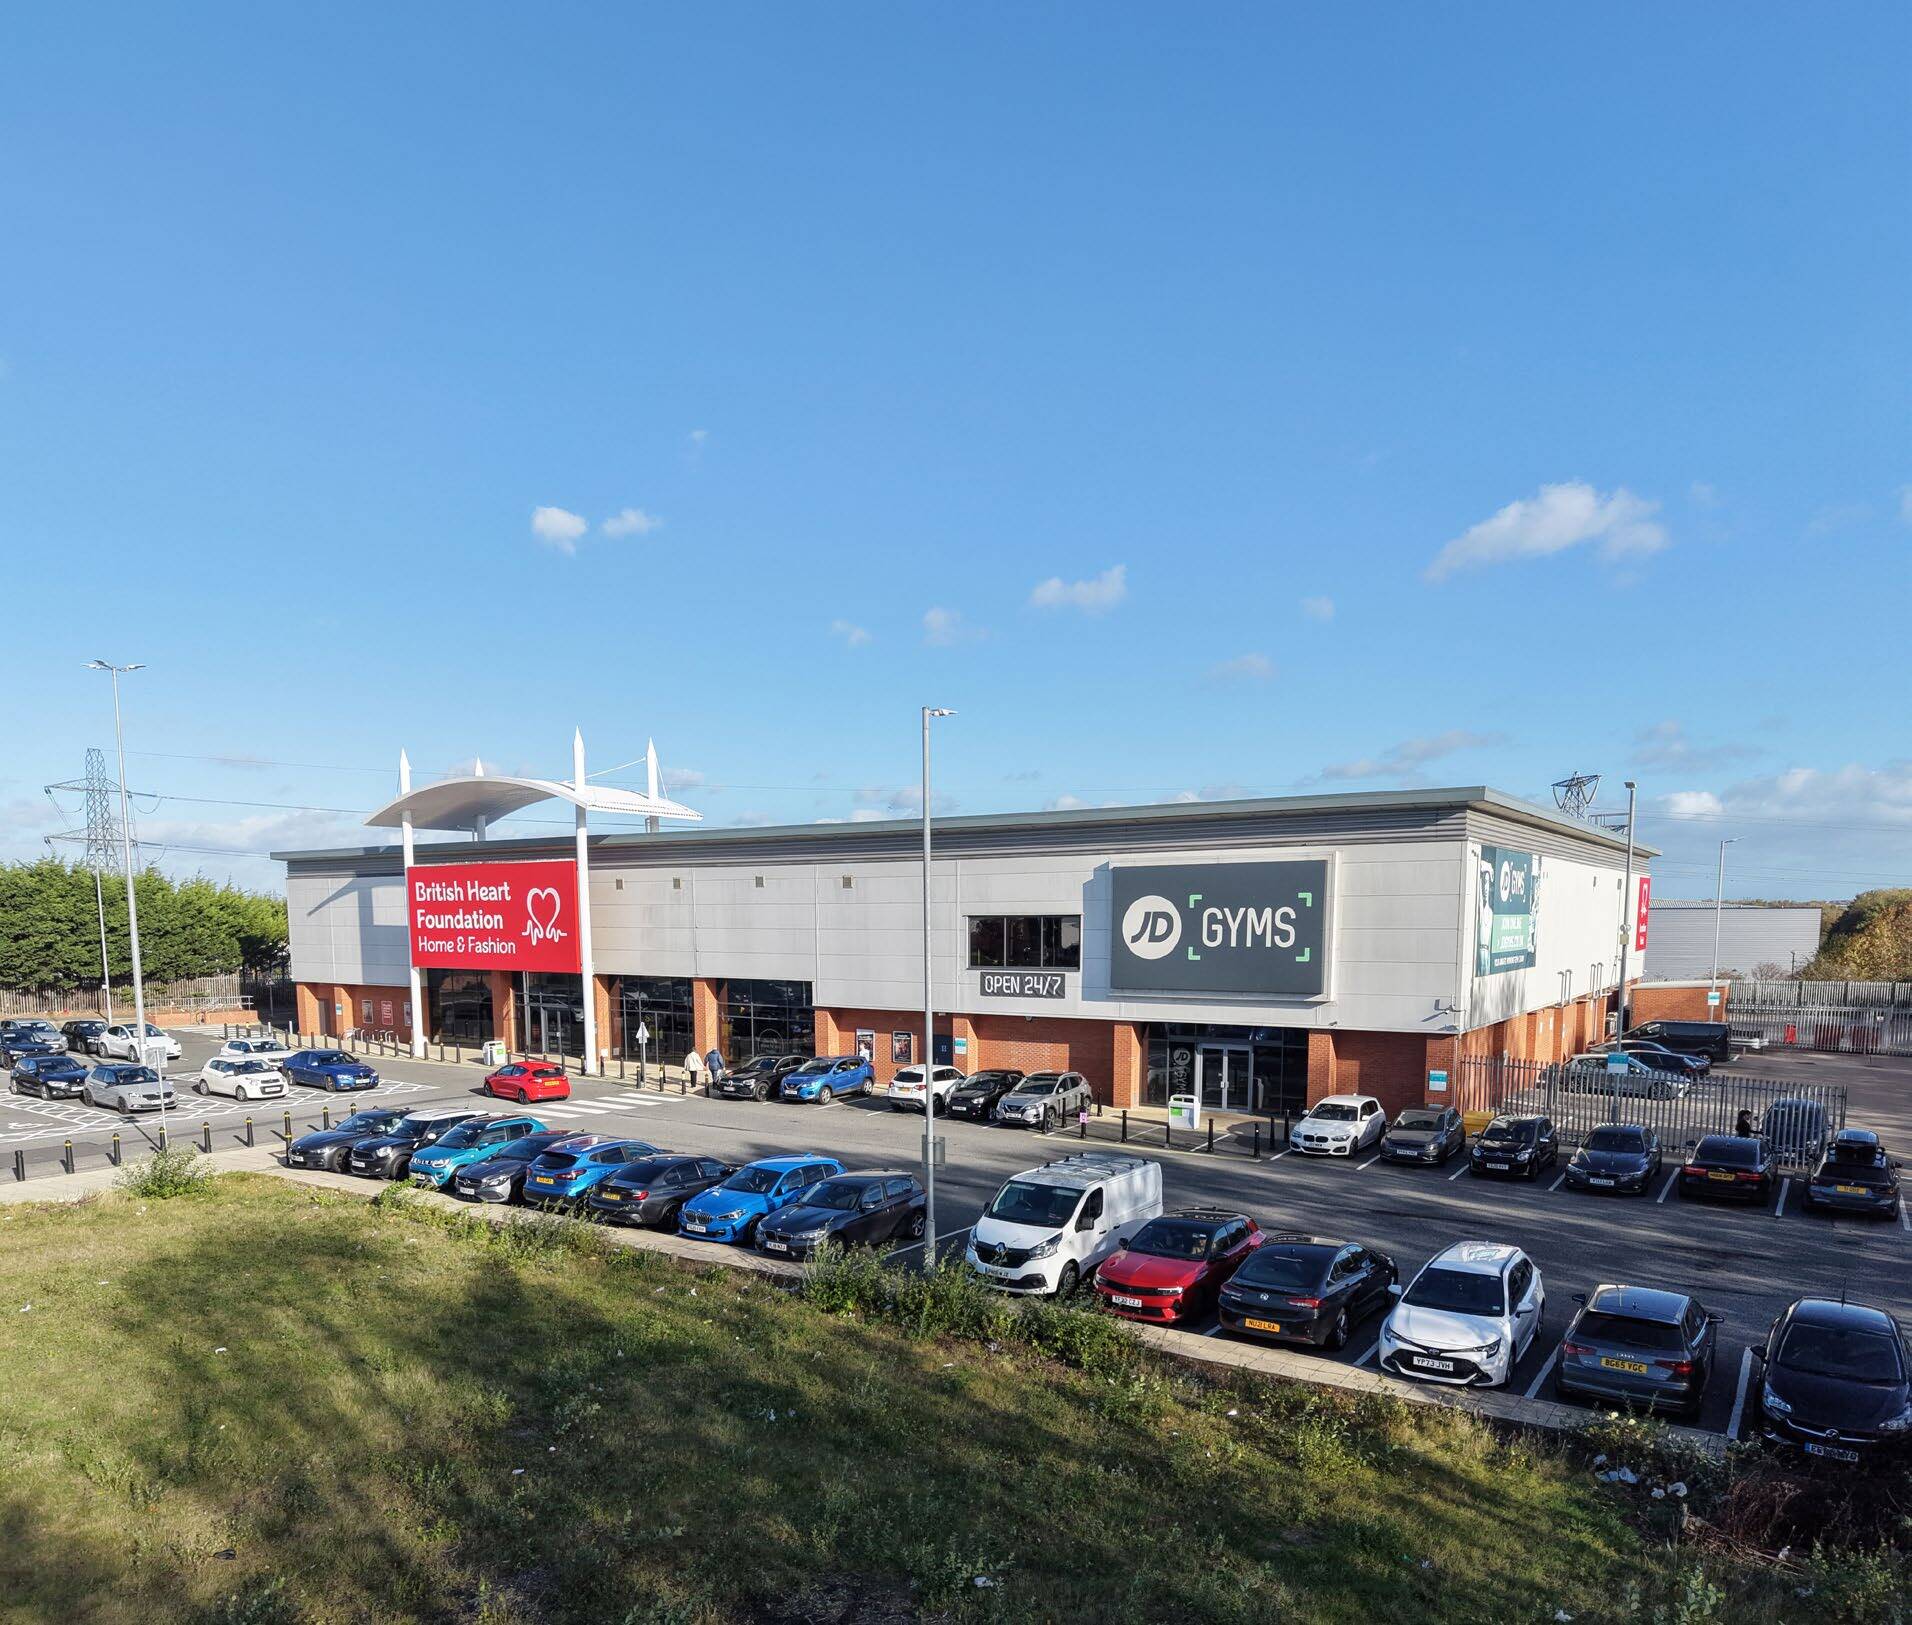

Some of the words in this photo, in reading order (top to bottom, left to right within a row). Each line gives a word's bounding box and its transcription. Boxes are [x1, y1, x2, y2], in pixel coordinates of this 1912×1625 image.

[415, 880, 464, 902] British
[466, 880, 511, 902] Heart
[1511, 869, 1525, 895] GYMS
[416, 908, 504, 929] Foundation
[1131, 911, 1174, 944] JD
[1202, 906, 1296, 948] GYMS
[418, 936, 454, 953] Home
[456, 936, 465, 953] &
[468, 936, 516, 954] Fashion
[984, 975, 1020, 994] OPEN
[1024, 975, 1061, 996] 24/7
[1416, 1358, 1435, 1367] YP73
[1605, 1358, 1626, 1369] BG65
